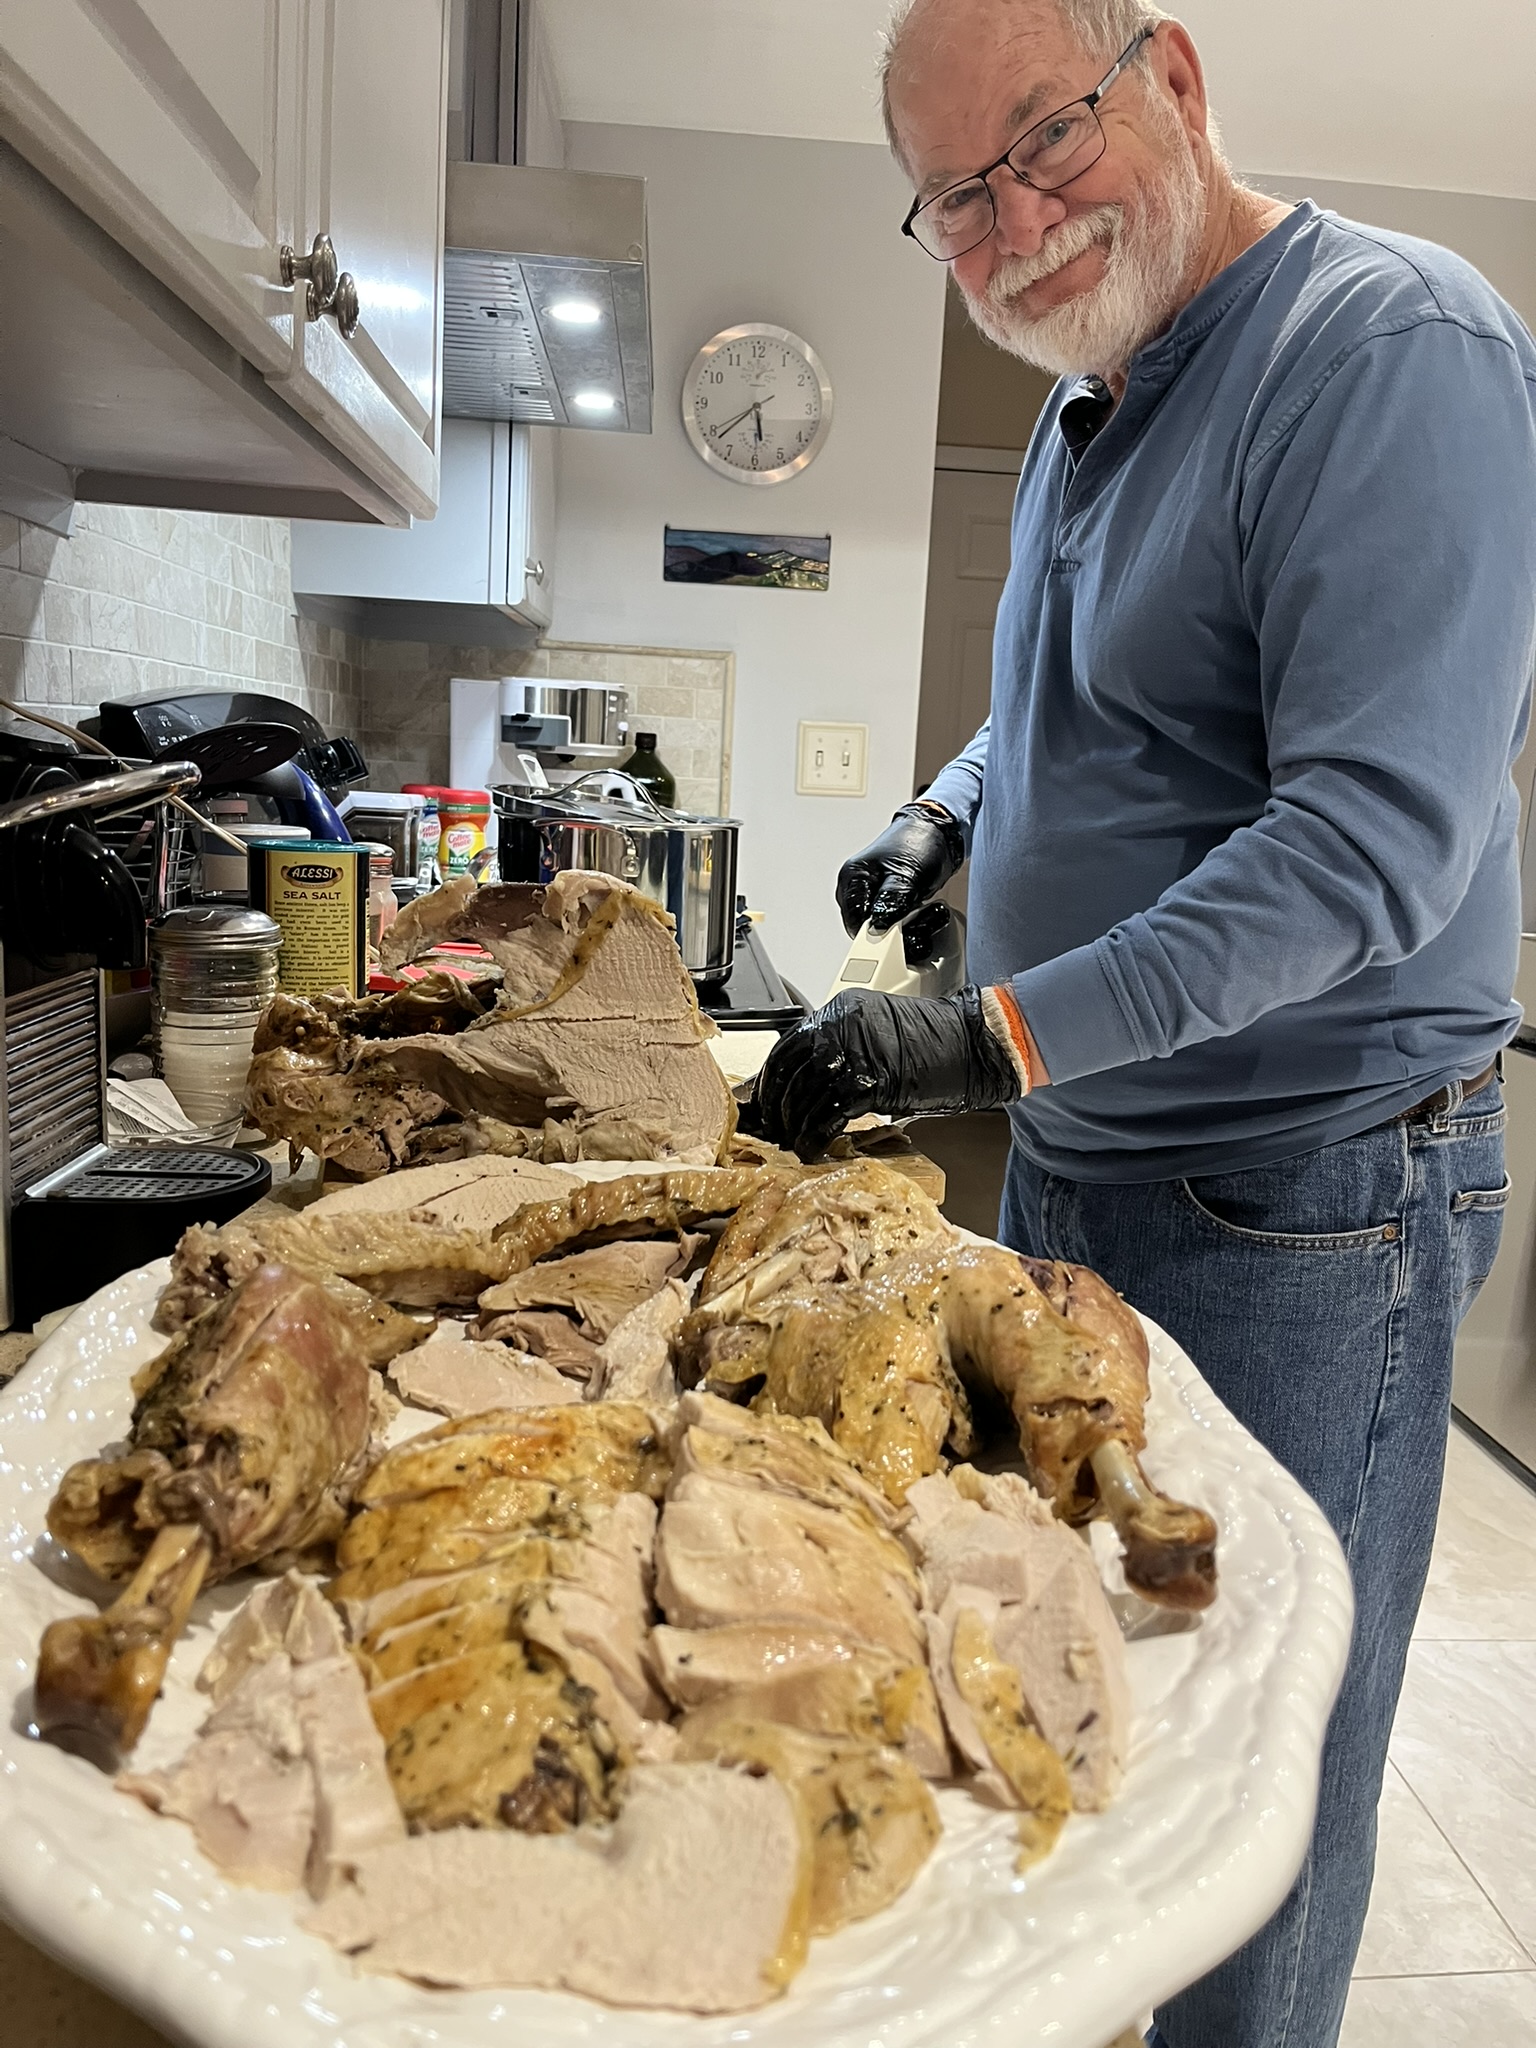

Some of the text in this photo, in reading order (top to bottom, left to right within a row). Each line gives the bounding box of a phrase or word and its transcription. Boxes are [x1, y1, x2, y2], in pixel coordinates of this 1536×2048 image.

[752, 346, 765, 358] 12
[729, 354, 741, 366] 11
[781, 355, 786, 367] 1
[710, 372, 723, 384] 10
[798, 374, 805, 386] 2
[701, 397, 708, 409] 9
[805, 403, 812, 415] 3
[710, 425, 717, 436] 8
[796, 431, 802, 443] 4
[727, 445, 733, 456] 7
[777, 448, 784, 460] 5
[751, 454, 759, 466] 6
[450, 855, 469, 864] ZERO
[292, 868, 333, 878] ALESSI
[283, 891, 341, 900] SEA SALT
